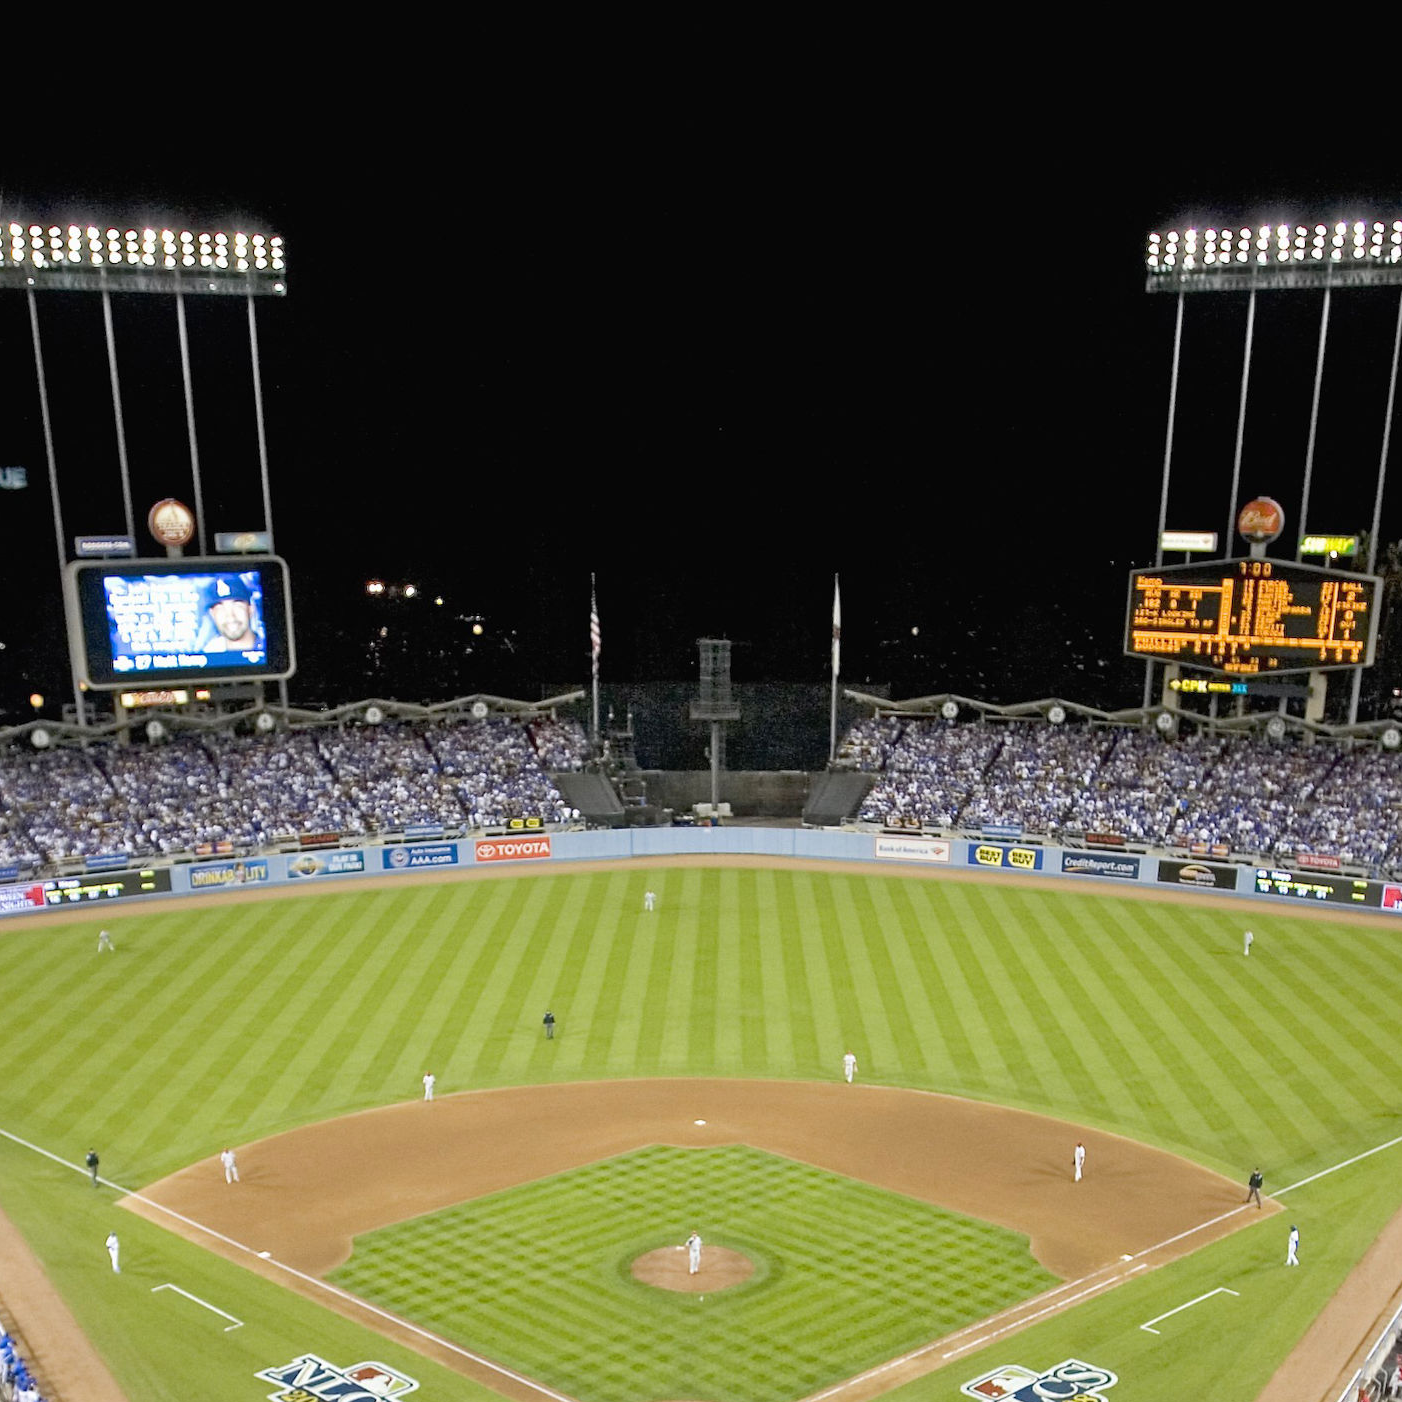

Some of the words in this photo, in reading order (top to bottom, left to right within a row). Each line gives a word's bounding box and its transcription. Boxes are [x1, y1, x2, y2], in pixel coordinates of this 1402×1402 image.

[497, 842, 549, 855] TOYOTA
[979, 849, 1001, 858] BEST
[1012, 852, 1034, 861] BEST
[411, 855, 452, 865] AAA.com
[979, 855, 999, 863] BUY
[1012, 857, 1032, 865] BUY
[1310, 857, 1339, 867] TOYOTA
[1064, 856, 1135, 872] CreditReport.com
